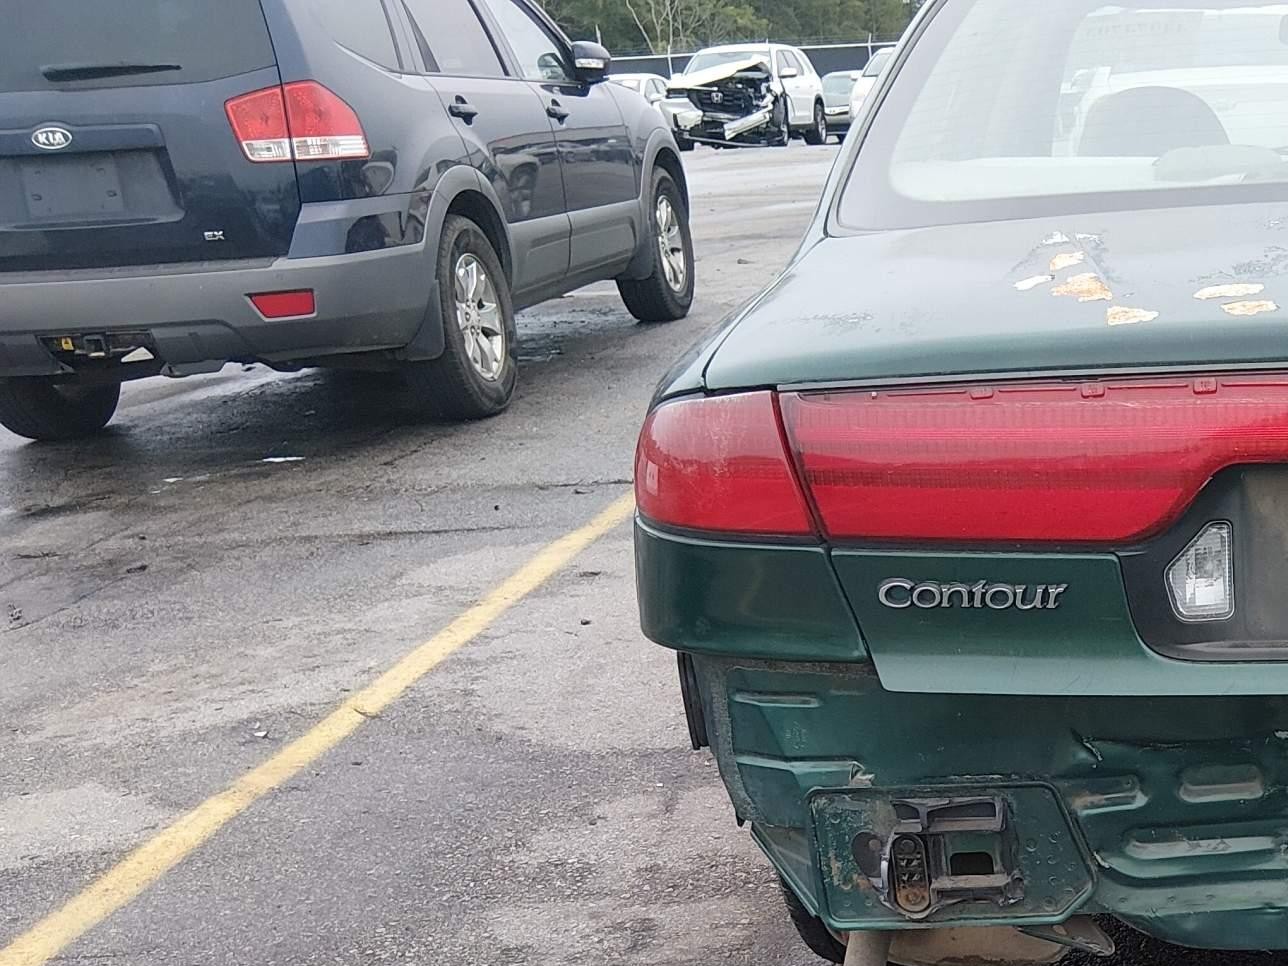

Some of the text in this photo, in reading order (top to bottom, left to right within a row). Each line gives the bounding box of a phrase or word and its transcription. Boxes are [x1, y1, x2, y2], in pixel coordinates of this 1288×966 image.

[37, 131, 67, 146] KIA
[203, 230, 225, 241] EX
[877, 577, 1068, 609] Contour
